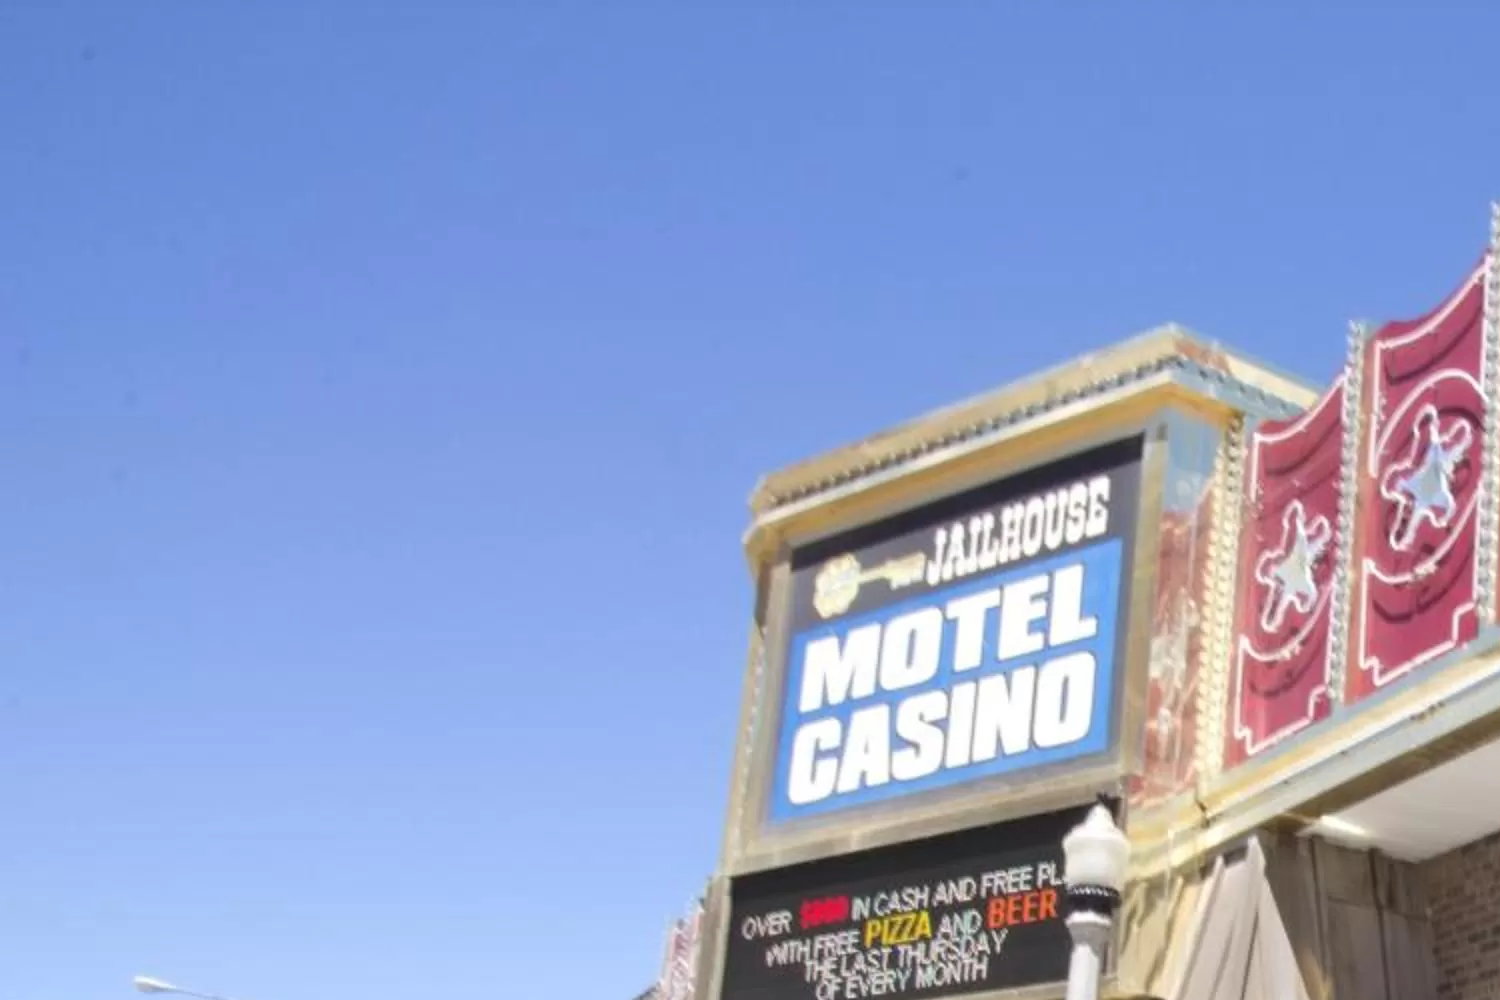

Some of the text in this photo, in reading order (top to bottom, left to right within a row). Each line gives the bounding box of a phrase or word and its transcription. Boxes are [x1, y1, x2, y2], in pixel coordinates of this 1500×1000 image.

[927, 475, 1110, 586] JAILHOUSE
[799, 564, 1098, 713] MOTEL
[788, 651, 1096, 805] CASINO
[742, 910, 792, 940] OVER
[851, 896, 871, 921] IN
[874, 885, 929, 916] CASH
[932, 877, 976, 906] AND
[980, 865, 1034, 898] FREE
[1037, 860, 1067, 889] PL
[814, 930, 860, 959] FREE
[864, 910, 932, 948] PIZZA
[938, 908, 982, 937] AND
[986, 888, 1058, 929] BEER
[804, 928, 1008, 983] THE LAST THURSDAY
[845, 967, 912, 999] EVERY
[915, 954, 989, 990] MONTH
